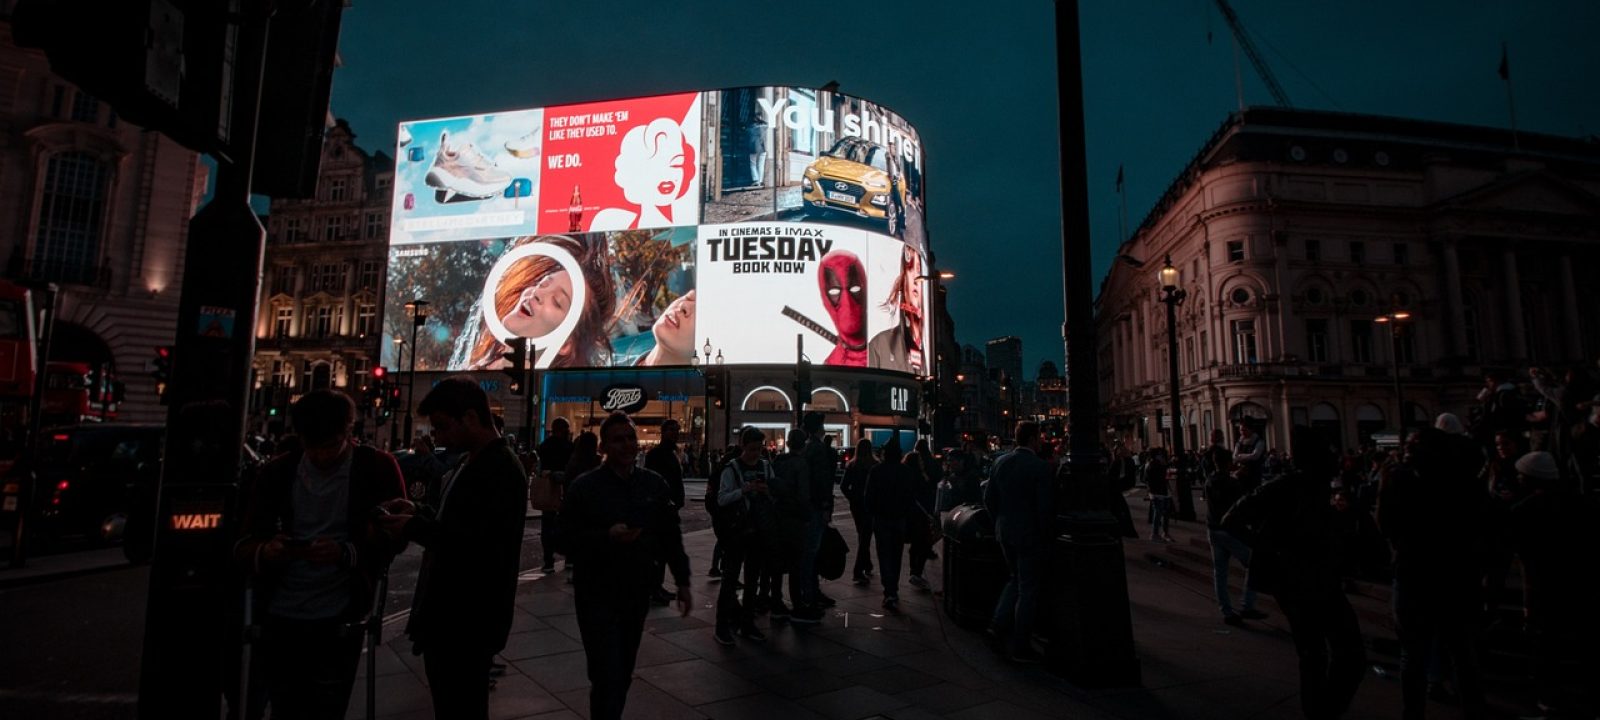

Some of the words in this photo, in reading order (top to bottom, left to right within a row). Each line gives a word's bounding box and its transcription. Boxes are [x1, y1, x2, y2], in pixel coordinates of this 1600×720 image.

[550, 117, 568, 128] THEY
[569, 114, 591, 126] DON'T
[592, 112, 613, 124] MAKE
[758, 98, 834, 133] You
[549, 129, 565, 141] LIKE
[567, 127, 586, 139] THEY
[586, 126, 605, 138] USED
[606, 125, 617, 135] TO.
[548, 154, 564, 169] WE
[565, 152, 582, 168] DO.
[719, 228, 728, 237] IN
[731, 227, 772, 237] CINEMAS
[775, 227, 781, 236] &
[785, 227, 824, 238] IMAX
[394, 247, 429, 258] SAMSUNG
[706, 236, 833, 262] TUESDAY
[732, 262, 770, 274] BOOK
[773, 262, 805, 274] NOW
[603, 387, 642, 410] Boots
[890, 386, 909, 412] GAP
[172, 513, 222, 529] WAIT
